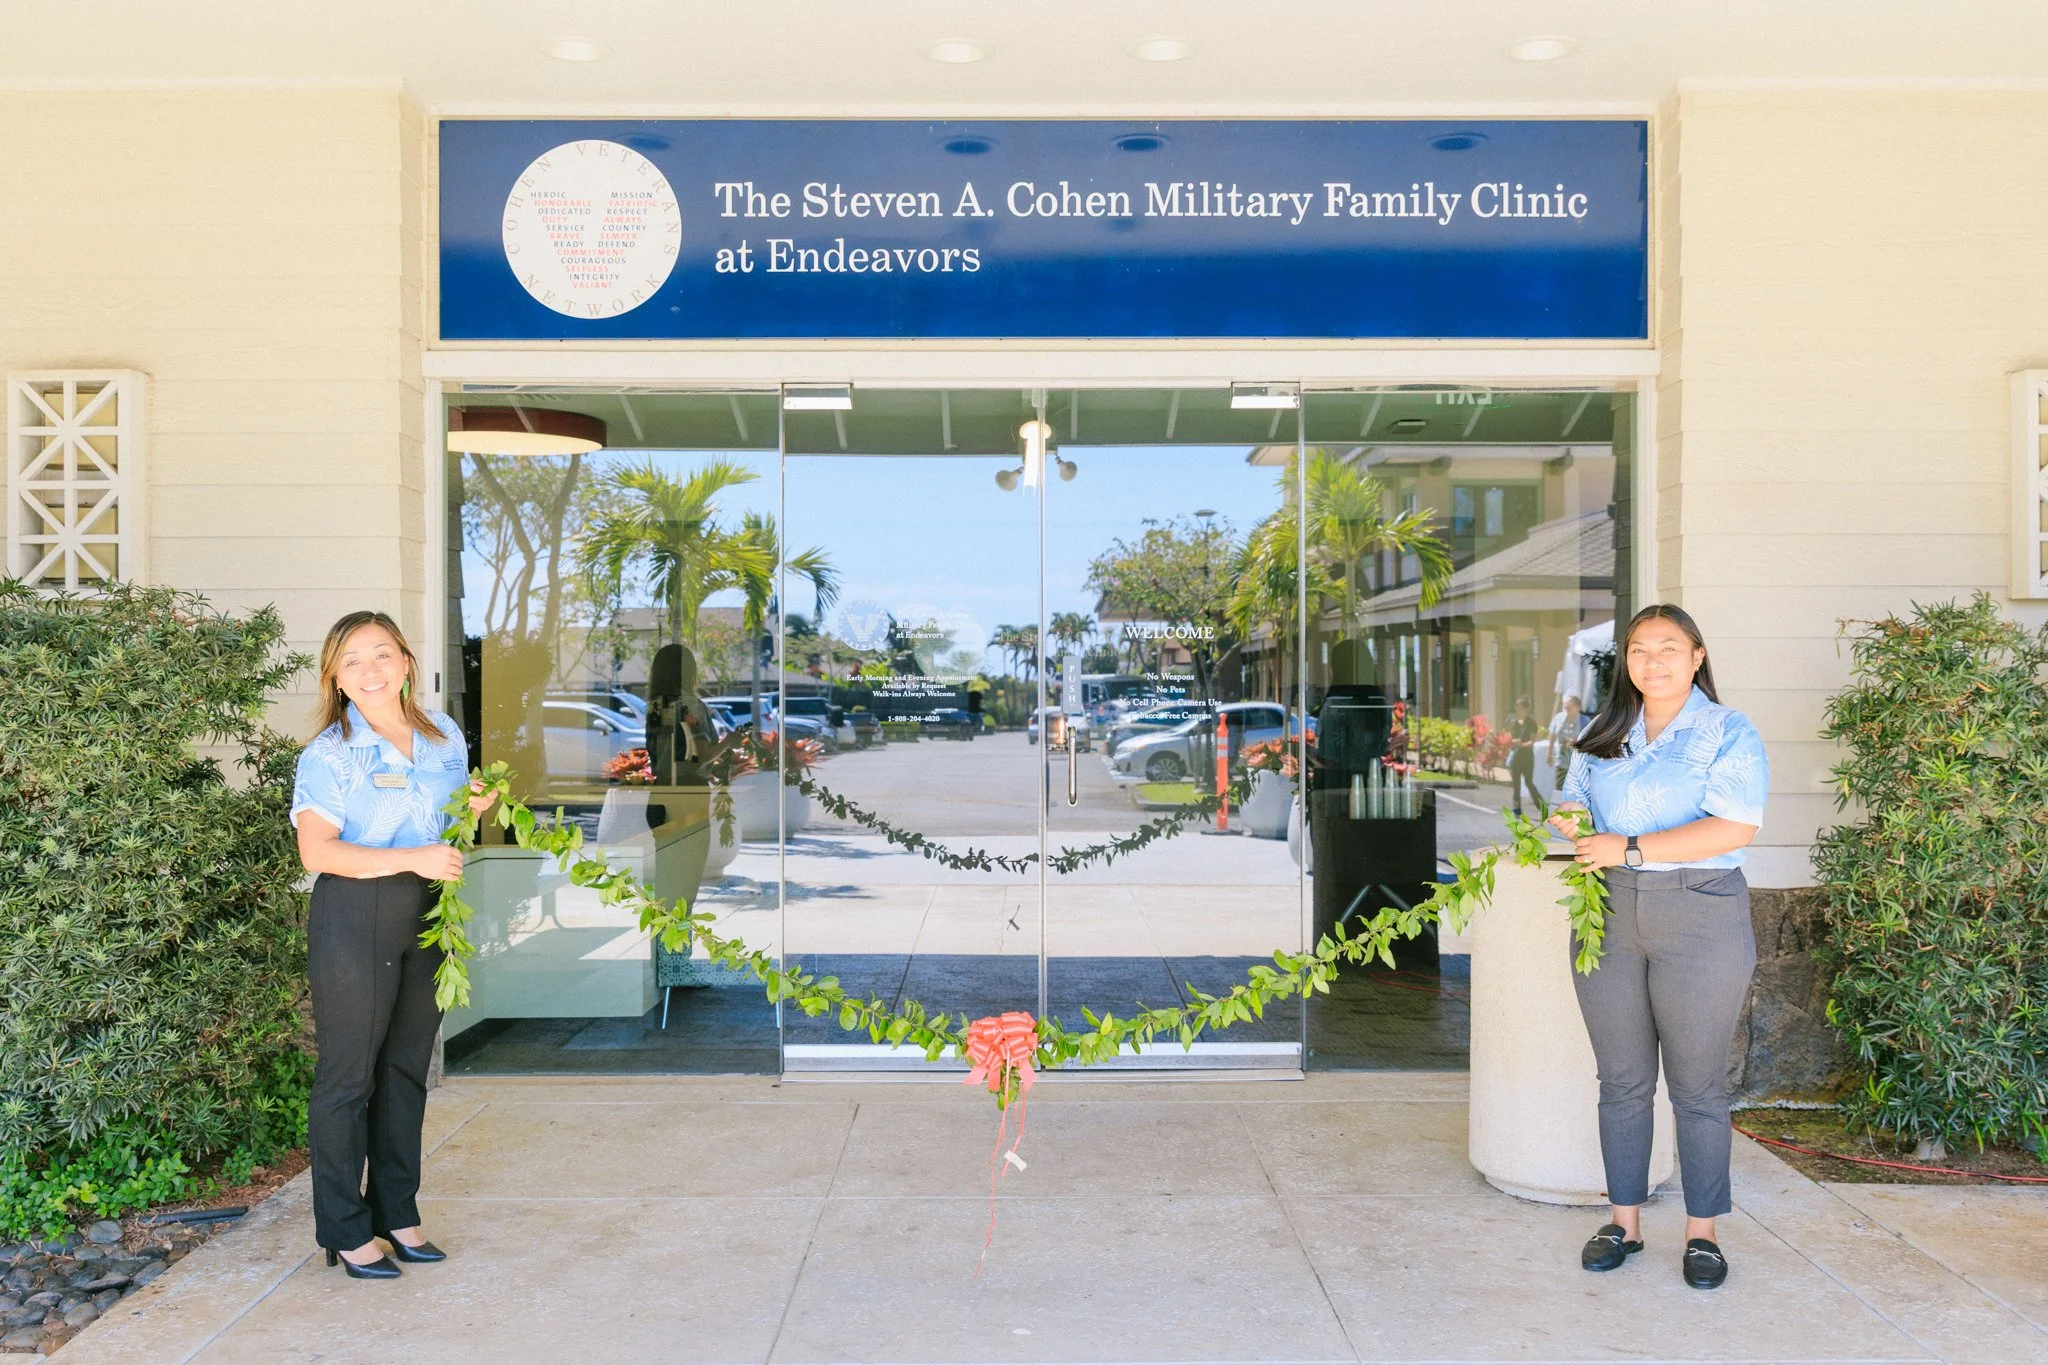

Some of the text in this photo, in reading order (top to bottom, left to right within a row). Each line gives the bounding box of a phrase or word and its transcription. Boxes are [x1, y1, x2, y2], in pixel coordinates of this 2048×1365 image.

[531, 191, 653, 199] HEROIC MISSION
[714, 179, 1588, 226] The Steven A. Cohen Military Family Clinic
[504, 143, 680, 317] COHEN VETERANS NETWORK
[550, 232, 638, 240] BRAVE SEMPER
[715, 238, 980, 273] at Endeavors
[566, 265, 608, 273] SELFLESS
[570, 273, 620, 281] INTEGRITY
[1126, 627, 1215, 639] WELCOME
[1161, 673, 1194, 683] Weapons
[1181, 712, 1212, 721] Campus
